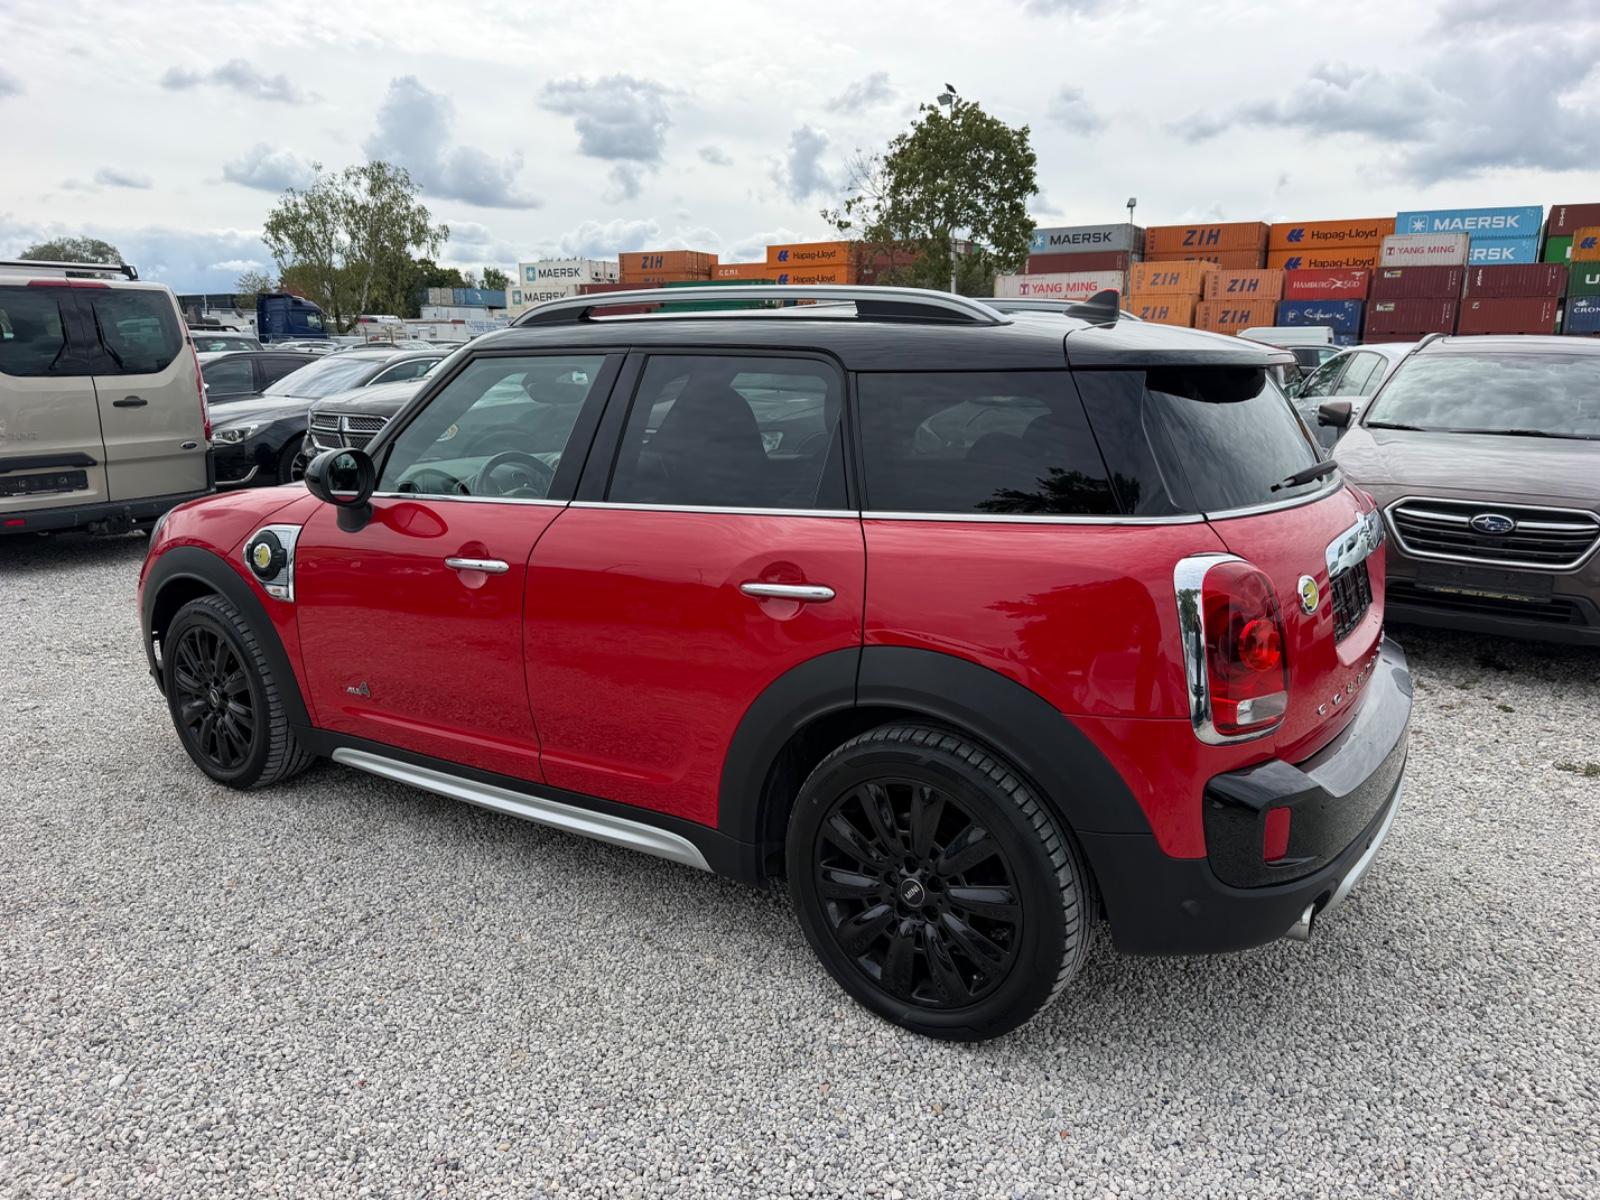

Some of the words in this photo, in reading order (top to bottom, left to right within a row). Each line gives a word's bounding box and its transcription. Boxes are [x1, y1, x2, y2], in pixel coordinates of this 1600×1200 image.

[1434, 215, 1520, 231] MAERSK
[1050, 231, 1112, 245] MAERSK
[1311, 228, 1378, 241] Hapag-Lloyd
[793, 250, 836, 260] Hapag-Lloyd
[1397, 246, 1425, 255] YANG
[1427, 245, 1455, 254] MING
[1309, 257, 1376, 268] Hapag-Lloyd
[538, 267, 581, 279] MAERSK
[1032, 283, 1063, 294] YANG
[1066, 281, 1098, 292] MING
[1292, 280, 1331, 290] HAMBURG
[524, 291, 566, 302] MAERSK
